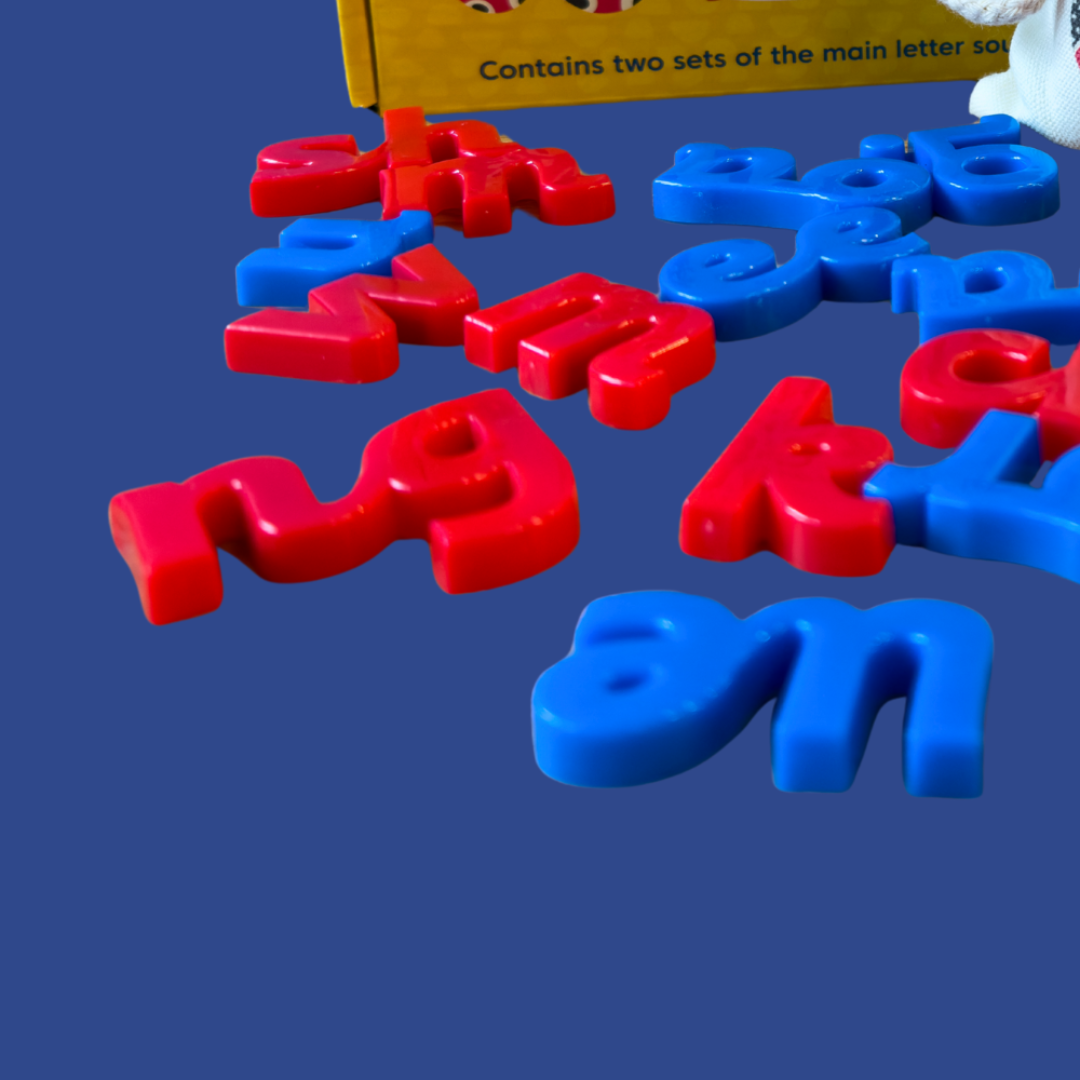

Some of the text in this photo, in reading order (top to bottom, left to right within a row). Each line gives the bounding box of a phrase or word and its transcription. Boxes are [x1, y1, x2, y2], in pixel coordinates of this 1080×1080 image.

[479, 54, 605, 81] Contains
[613, 52, 664, 73] two
[673, 49, 727, 70] sets
[735, 45, 762, 67] of
[771, 43, 814, 65] the
[823, 40, 887, 62] main
[897, 37, 965, 59] letter
